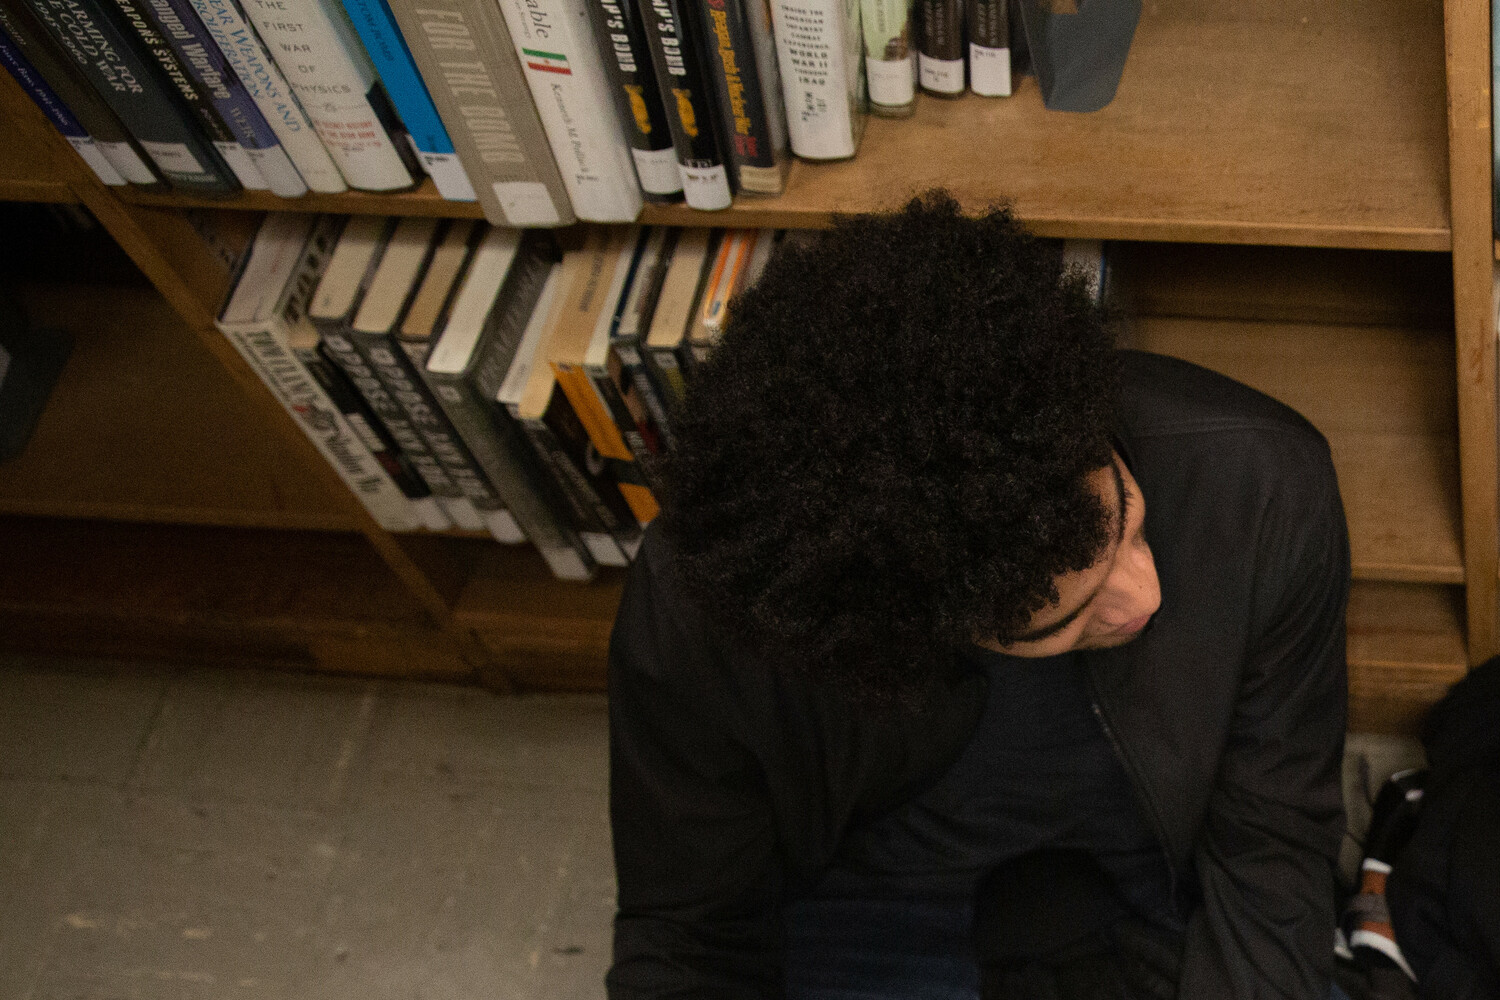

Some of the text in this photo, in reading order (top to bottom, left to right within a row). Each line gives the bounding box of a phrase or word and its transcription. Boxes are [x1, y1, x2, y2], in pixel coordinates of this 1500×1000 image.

[262, 20, 304, 33] FIRST
[416, 8, 477, 50] FOR
[58, 9, 127, 96] COLD WAR
[280, 42, 311, 54] WAR
[789, 49, 828, 58] WORLD
[113, 61, 144, 97] FOR
[151, 45, 200, 104] SYSTEMS
[180, 36, 235, 103] Warfare
[231, 28, 281, 100] WEAPONS
[272, 98, 302, 134] AND
[298, 63, 316, 74] OF
[439, 61, 497, 98] THE
